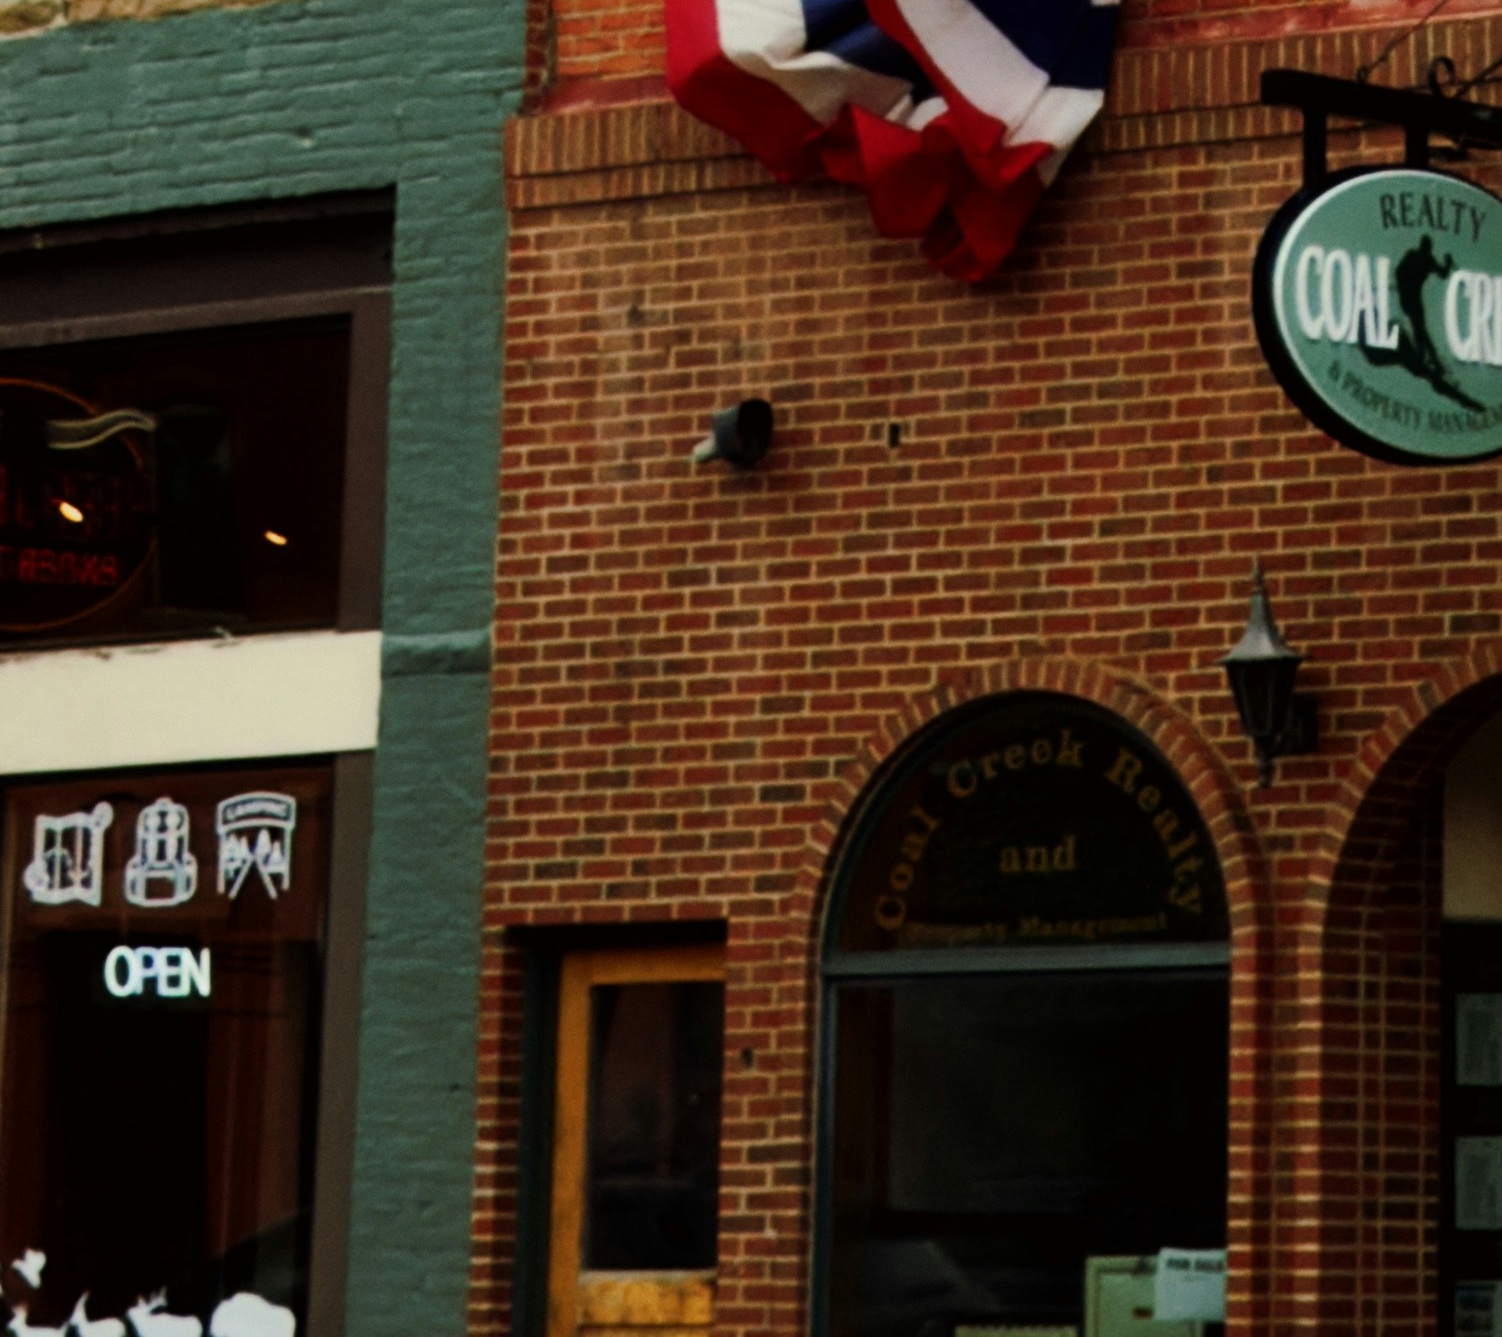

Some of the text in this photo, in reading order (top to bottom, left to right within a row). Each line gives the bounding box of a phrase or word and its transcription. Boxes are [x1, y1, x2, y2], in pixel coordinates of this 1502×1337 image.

[1379, 192, 1486, 242] REALTY
[1296, 244, 1399, 351] COAL
[873, 727, 1206, 933] Coal Creek Realty
[998, 833, 1079, 874] and
[104, 945, 211, 998] OPEN
